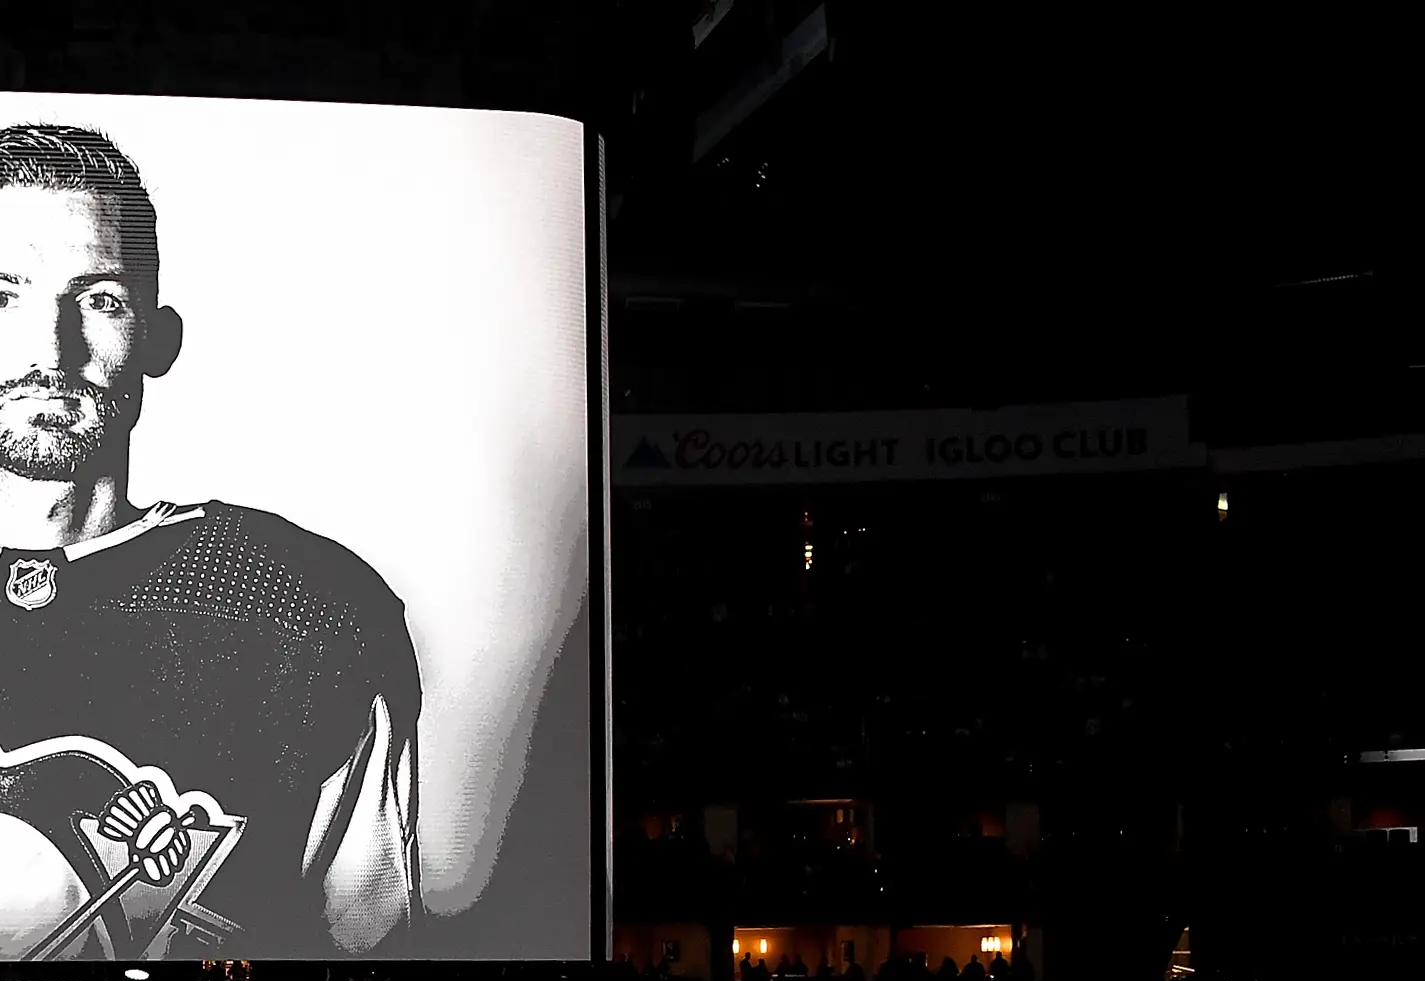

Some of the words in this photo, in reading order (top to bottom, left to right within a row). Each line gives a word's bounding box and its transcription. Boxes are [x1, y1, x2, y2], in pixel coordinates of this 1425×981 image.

[672, 429, 790, 469] Coors
[793, 436, 898, 469] LIGHT
[926, 433, 1044, 465] IGLOO
[1052, 427, 1148, 459] CLUB
[17, 572, 47, 598] NHL
